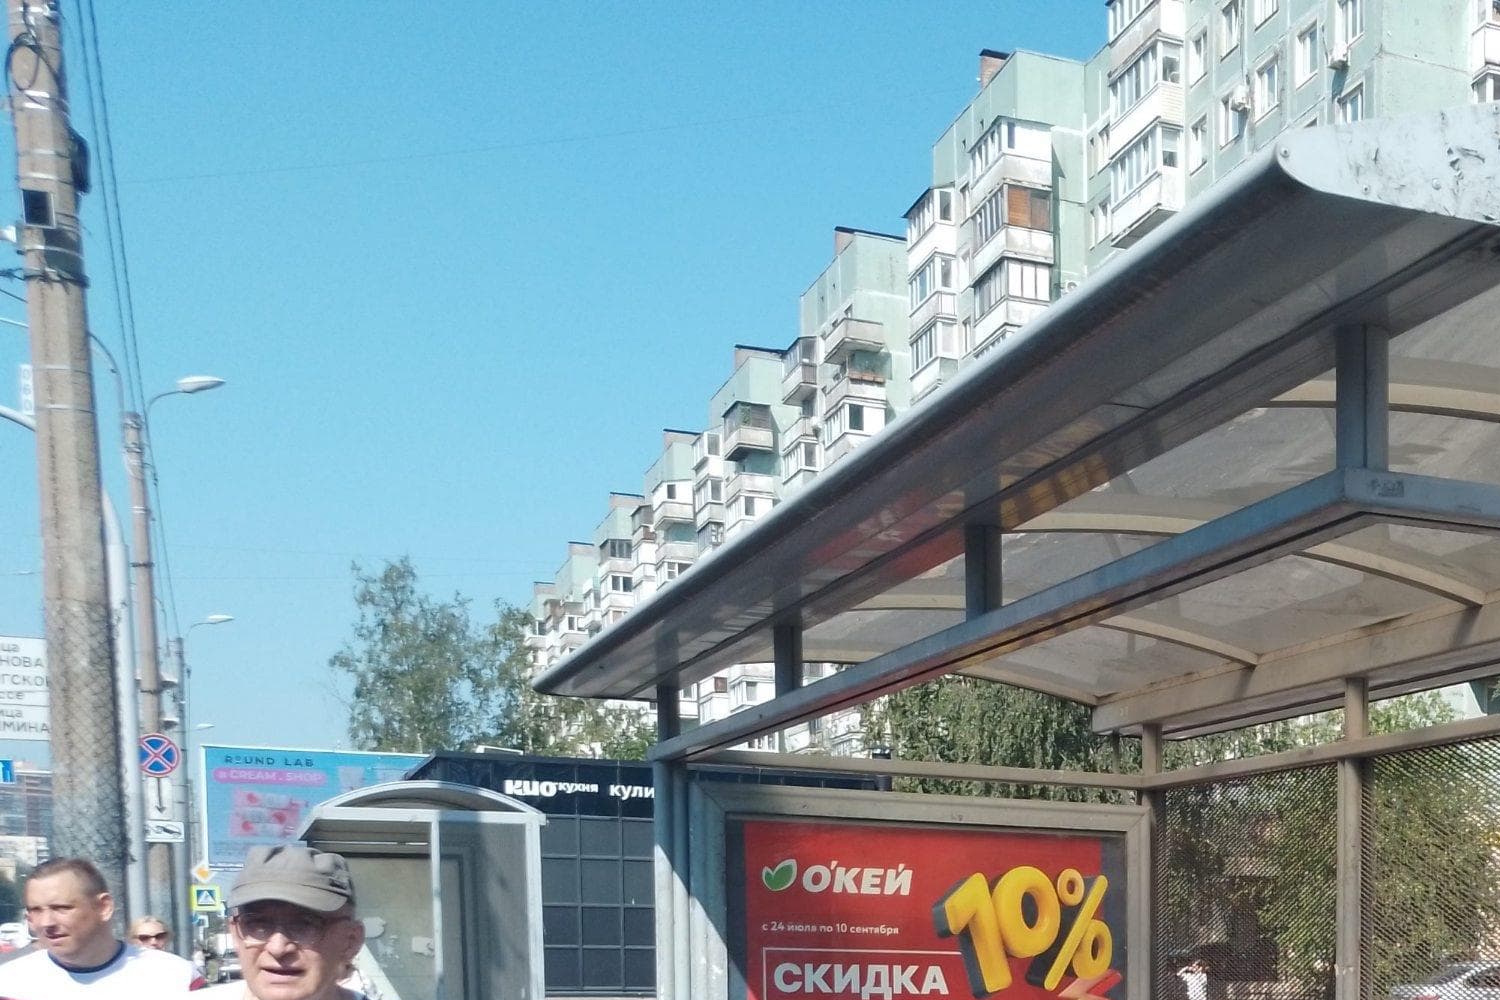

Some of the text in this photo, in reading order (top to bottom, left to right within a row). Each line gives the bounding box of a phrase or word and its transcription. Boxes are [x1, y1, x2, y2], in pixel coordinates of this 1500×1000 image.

[285, 758, 314, 766] LAB
[609, 784, 655, 800] кули
[770, 922, 786, 932] 24
[788, 923, 818, 933] июля
[820, 924, 834, 934] по
[836, 923, 849, 934] 10
[850, 924, 900, 936] сентября
[773, 963, 949, 1000] СКИДКА
